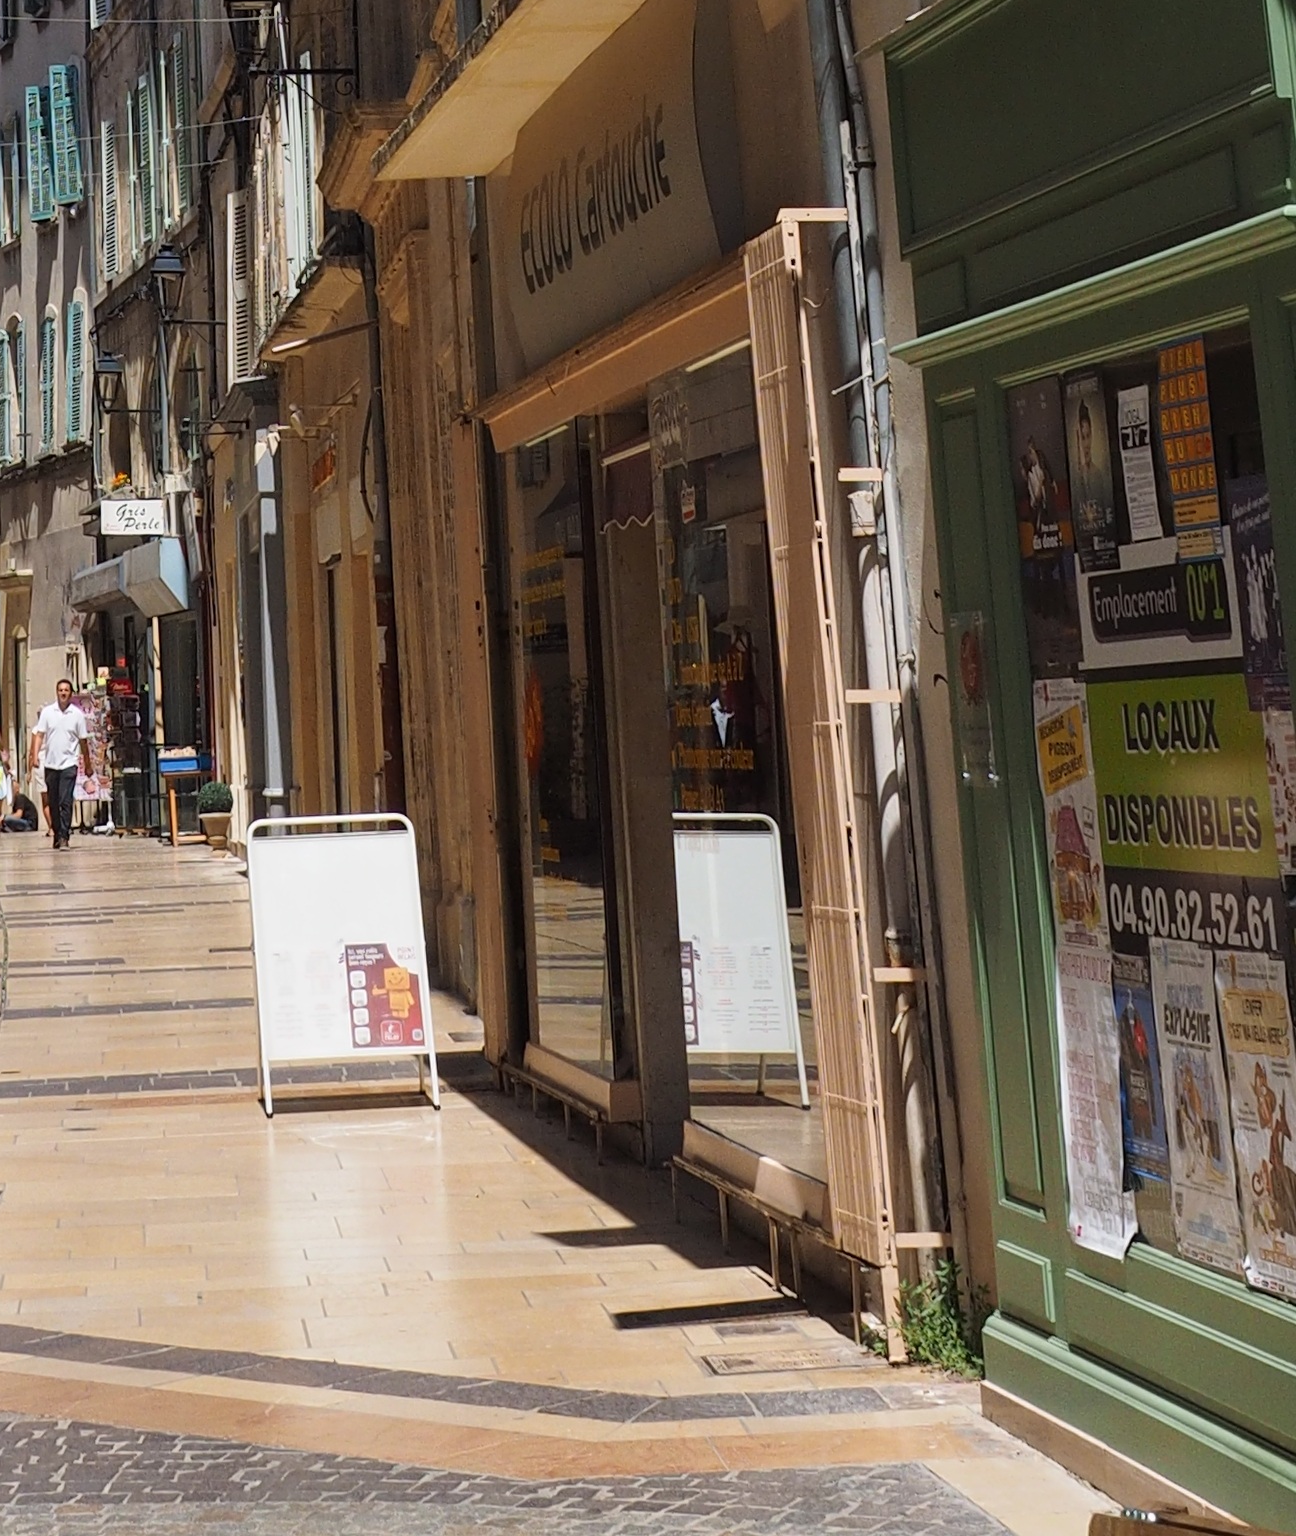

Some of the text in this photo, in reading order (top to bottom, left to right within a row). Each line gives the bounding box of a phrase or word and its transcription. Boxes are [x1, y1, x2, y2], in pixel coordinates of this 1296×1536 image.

[1170, 465, 1215, 493] MONDE
[116, 504, 145, 522] Gris
[124, 518, 159, 531] Perle
[1093, 577, 1177, 628] Emplacement
[1122, 699, 1220, 754] LOCAUX
[1049, 742, 1075, 756] PIGEON
[1104, 794, 1262, 853] DISPONIBLES
[1109, 882, 1278, 951] 04.90.82.52.61
[1164, 1004, 1210, 1044] EXPLOSIVE
